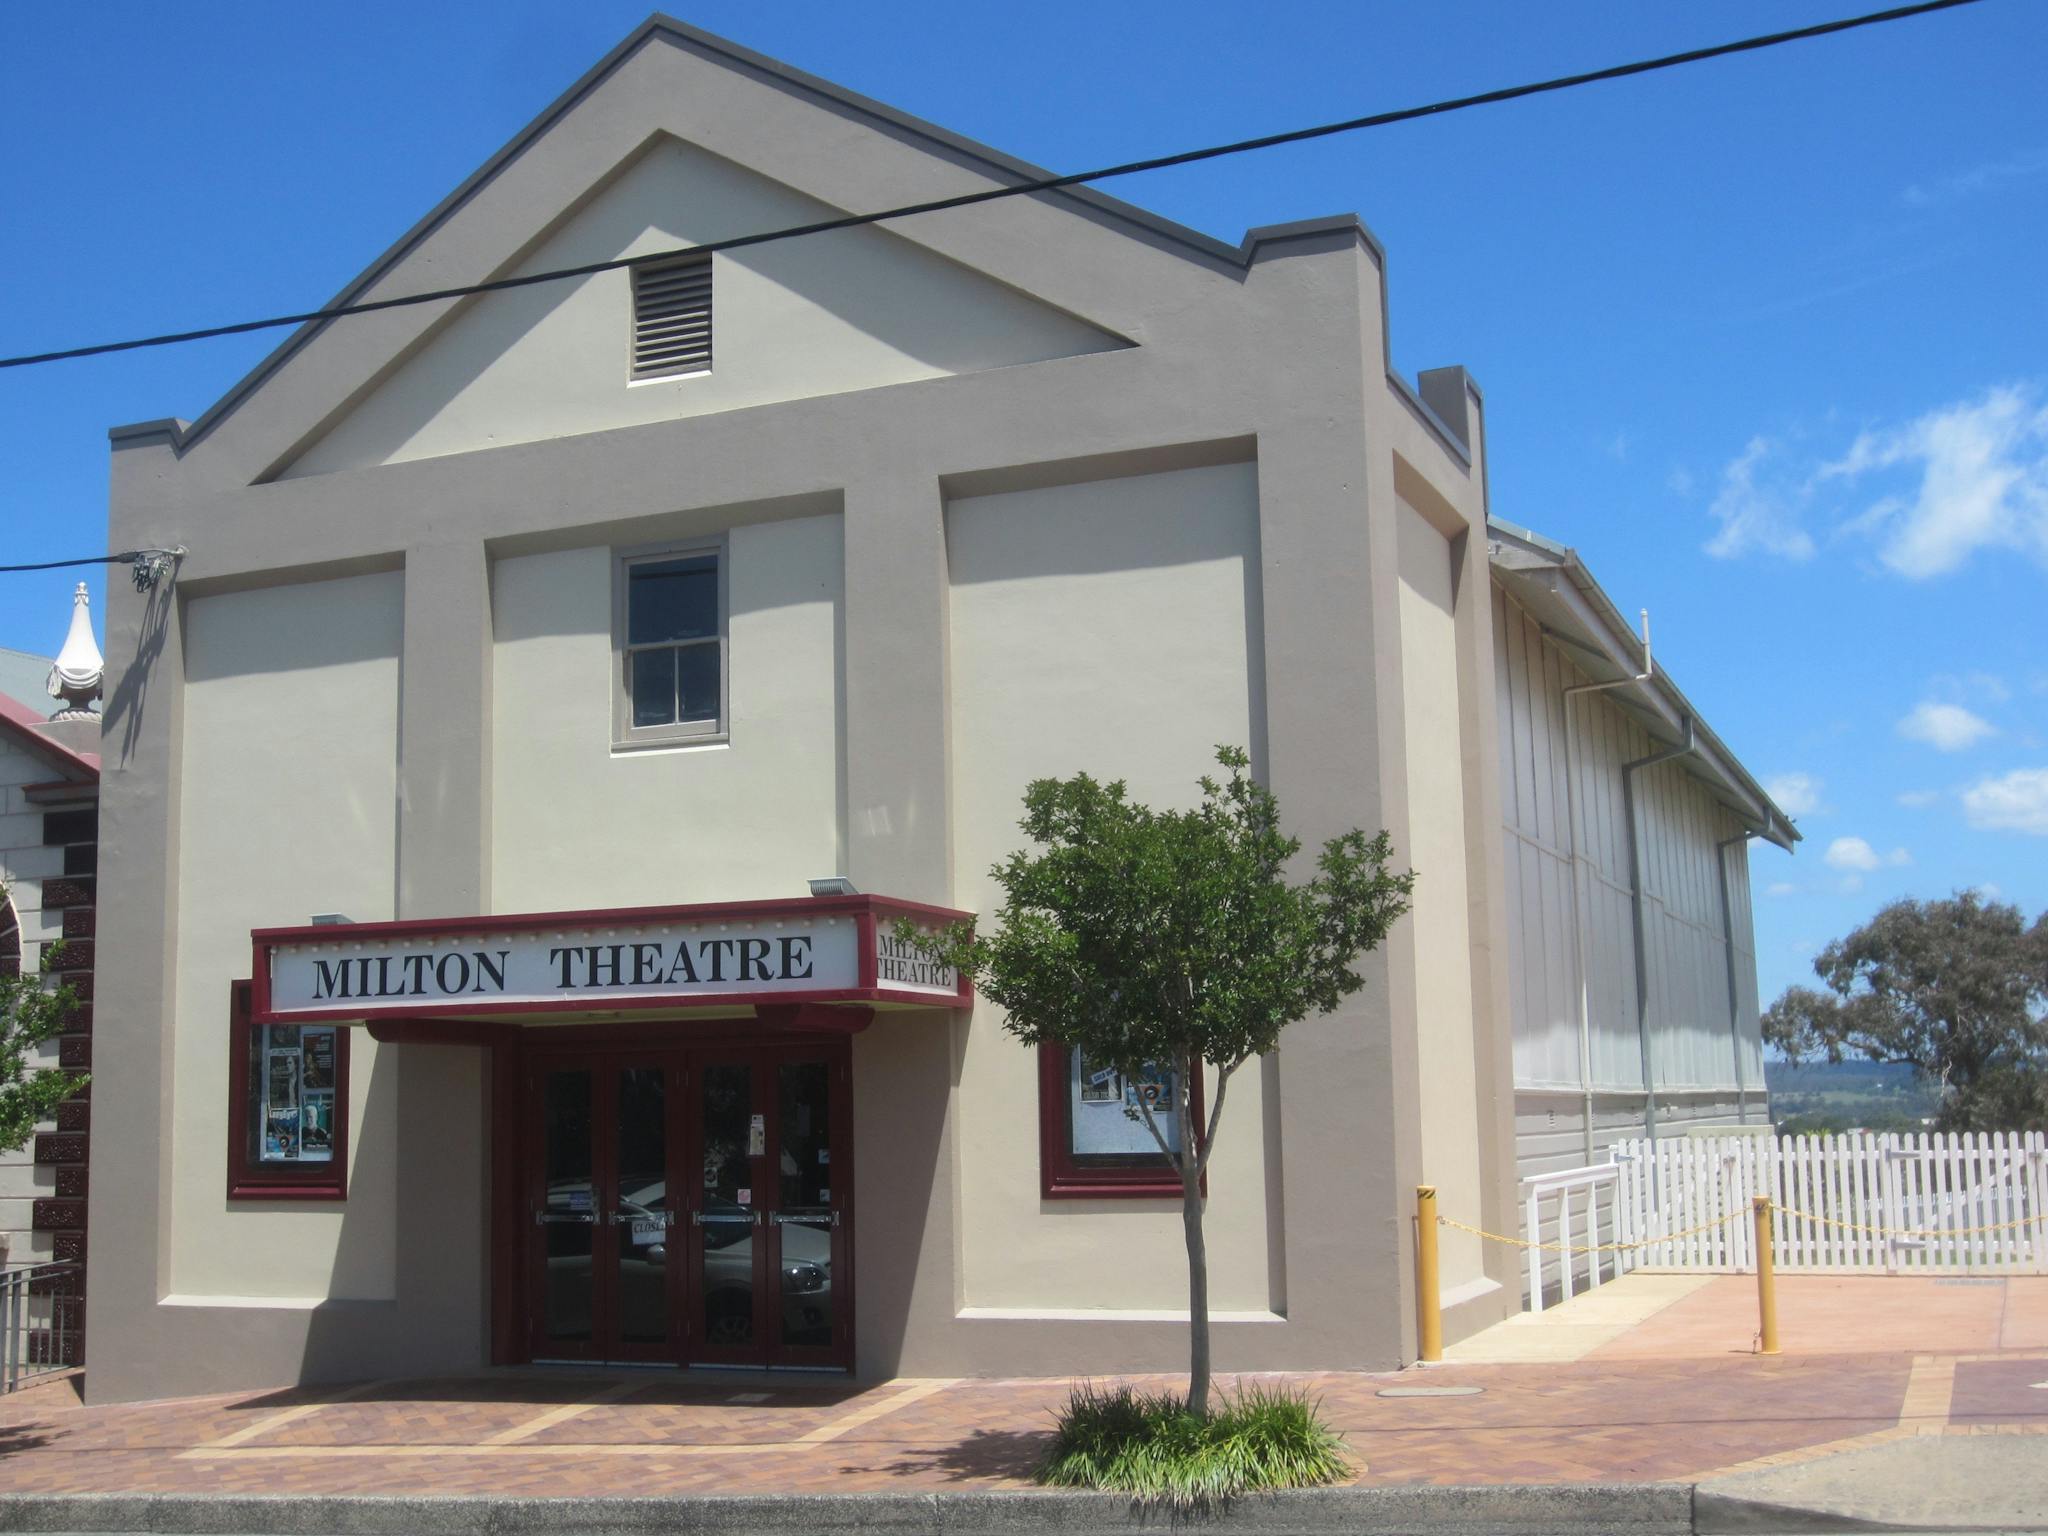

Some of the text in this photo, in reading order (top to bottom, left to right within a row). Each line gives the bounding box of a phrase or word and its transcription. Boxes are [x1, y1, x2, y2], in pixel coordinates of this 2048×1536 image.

[313, 936, 813, 999] MILTON THEATRE
[877, 957, 951, 987] THEATRE
